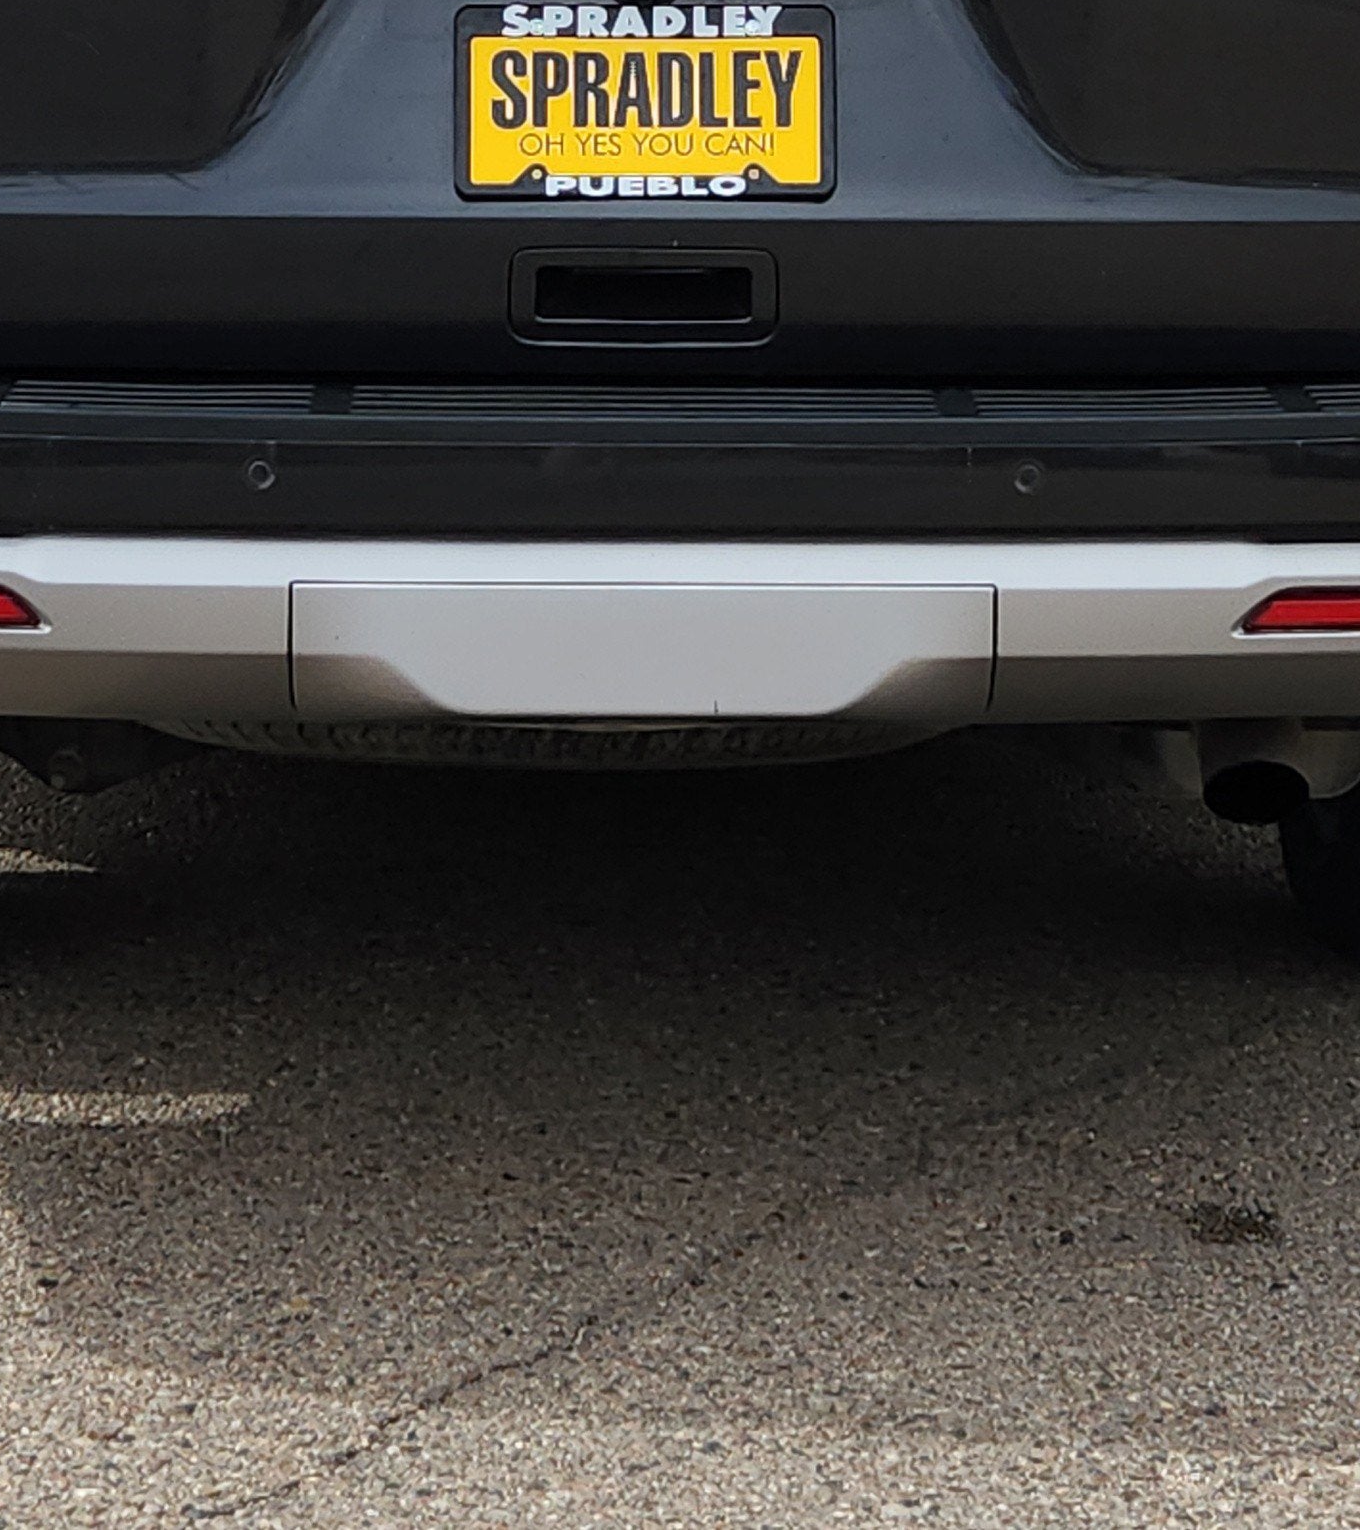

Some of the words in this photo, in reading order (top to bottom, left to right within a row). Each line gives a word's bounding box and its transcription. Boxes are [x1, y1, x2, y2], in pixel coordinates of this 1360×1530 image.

[501, 4, 783, 37] SPRADLEY
[491, 50, 803, 129] SPRADLEY
[519, 133, 564, 157] OH
[574, 133, 622, 157] YES
[632, 133, 695, 157] YOU
[704, 133, 775, 157] CAN!
[544, 175, 747, 197] PUEBLO
